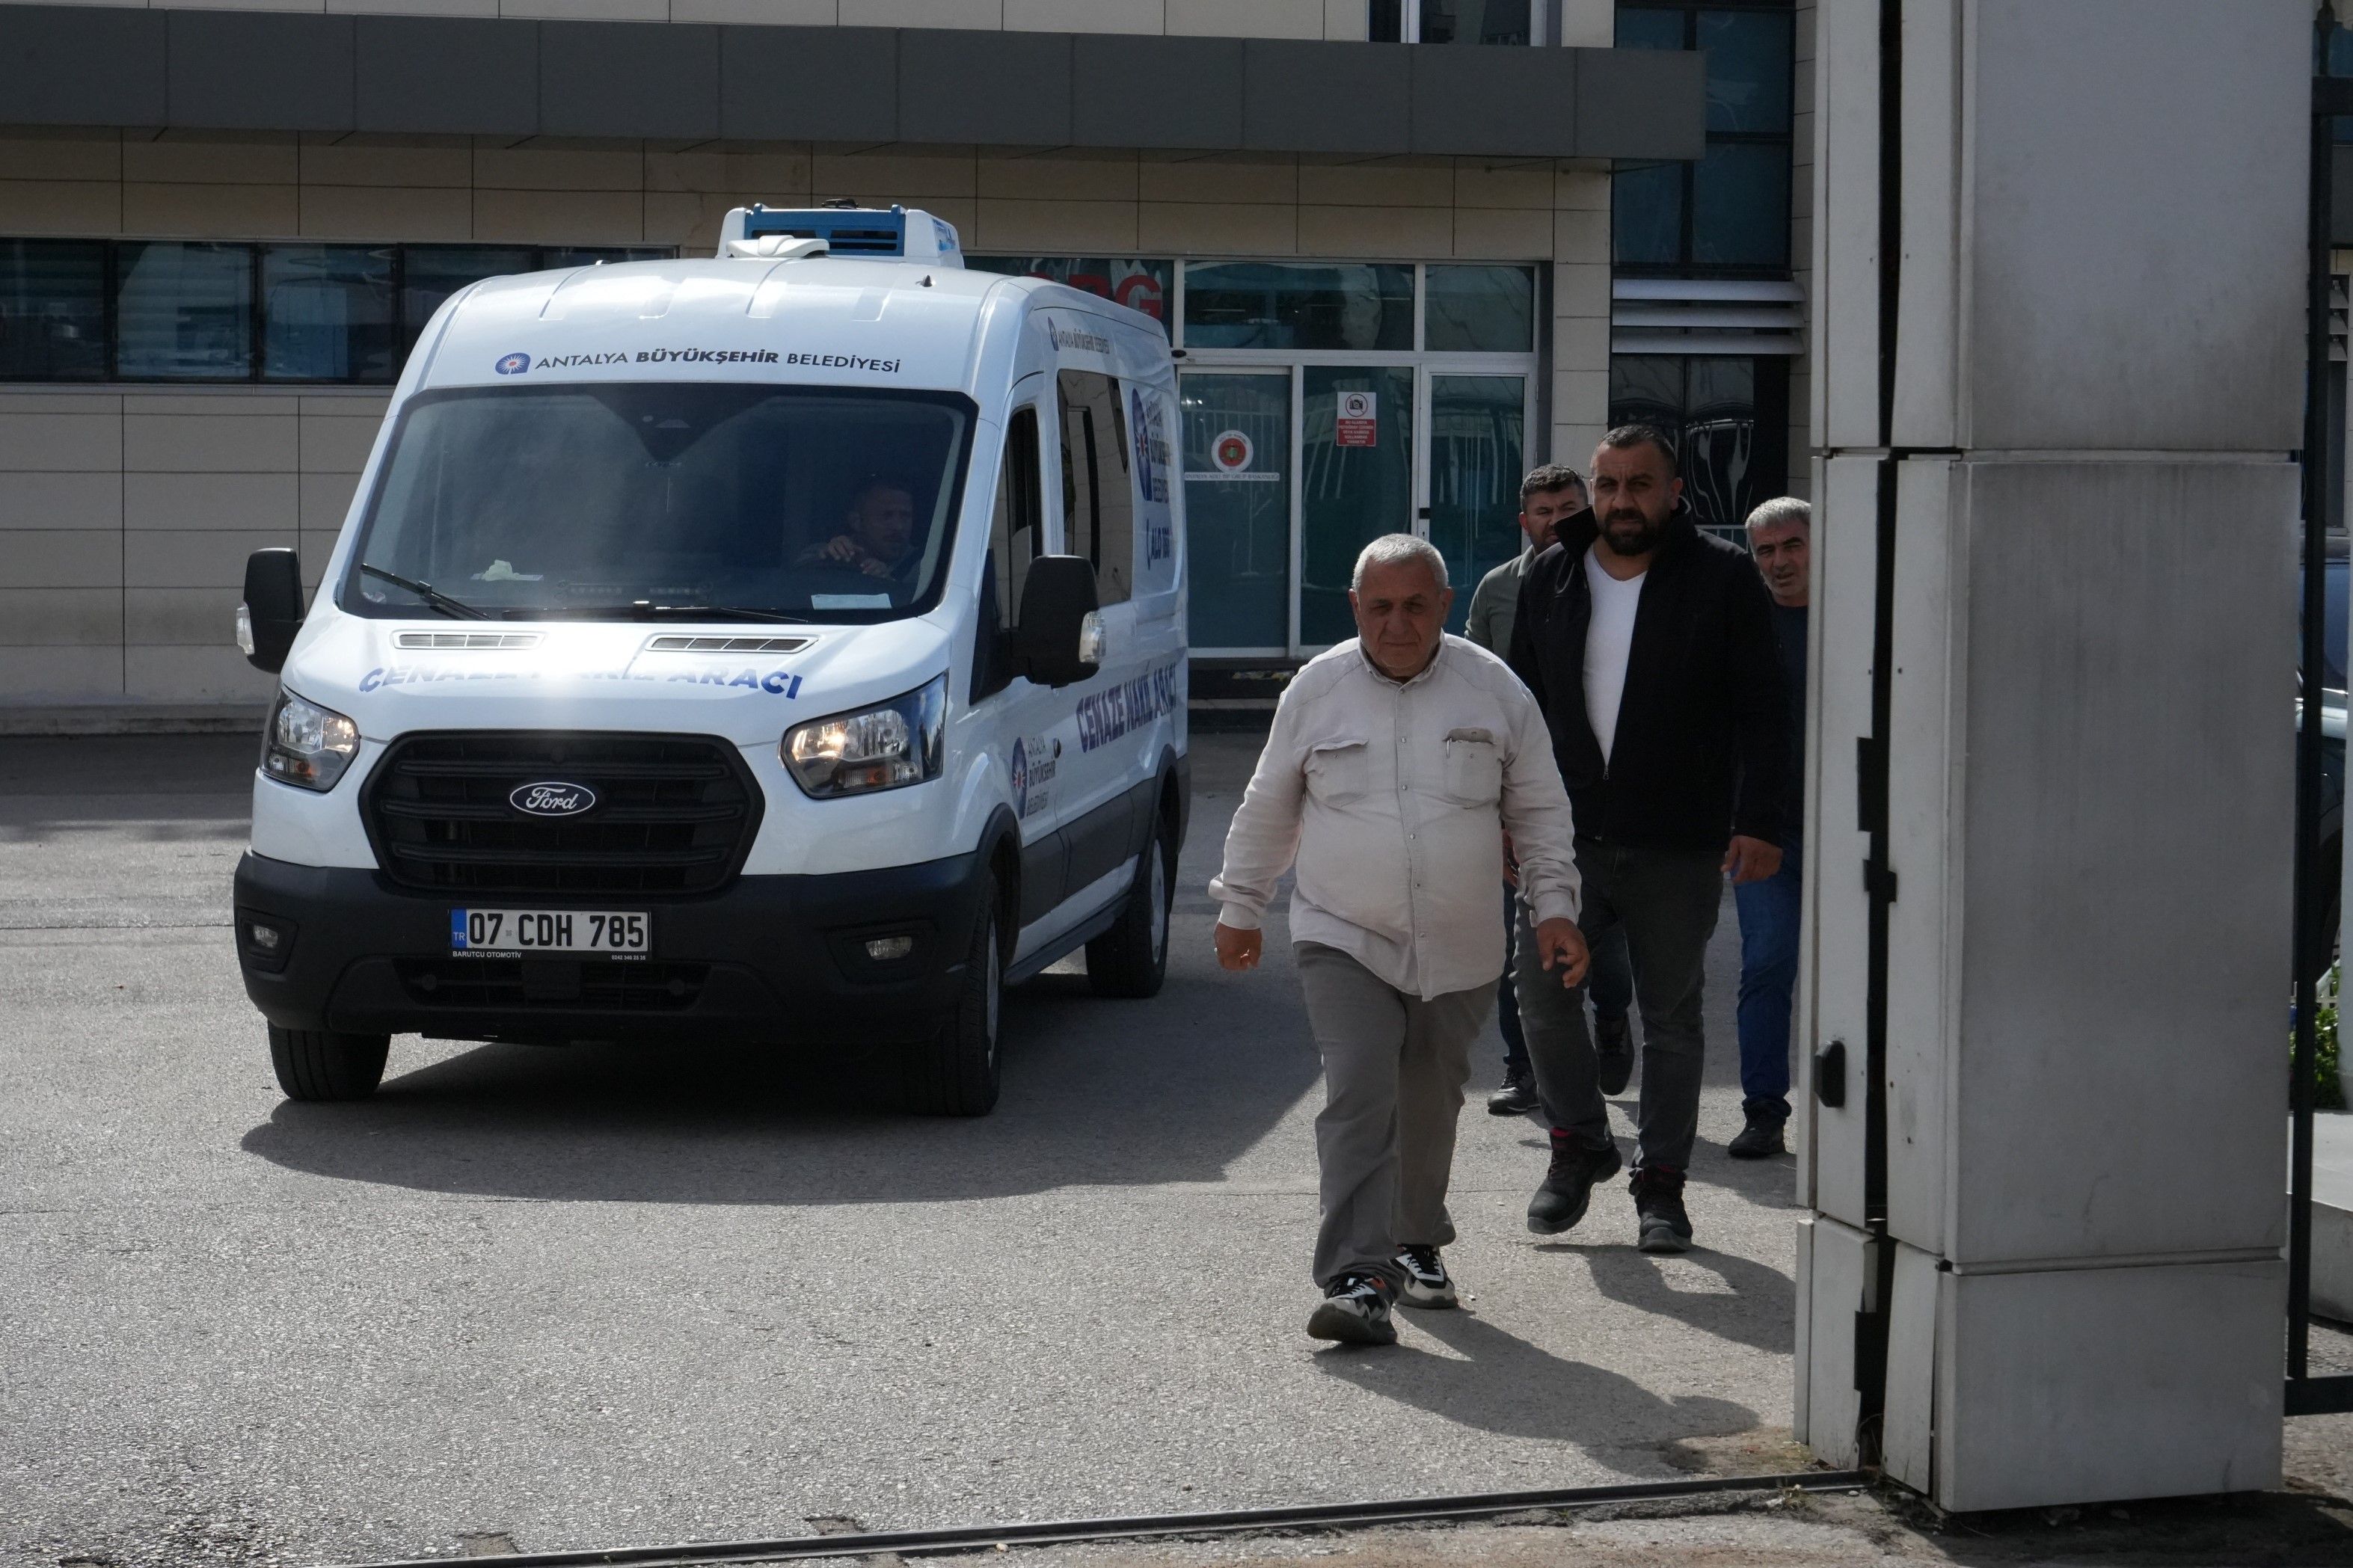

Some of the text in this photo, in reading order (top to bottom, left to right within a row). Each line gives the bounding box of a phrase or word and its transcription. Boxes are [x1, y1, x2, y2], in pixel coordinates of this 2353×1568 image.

[535, 348, 900, 373] ANTALYA BÜYÜKŞEHİR BELEDİYESİ
[359, 664, 517, 692] CENA
[667, 666, 803, 700] ARACI
[1076, 682, 1124, 753] CENAZE
[526, 787, 579, 810] Ford
[453, 913, 643, 947] TR 07 CDH 785
